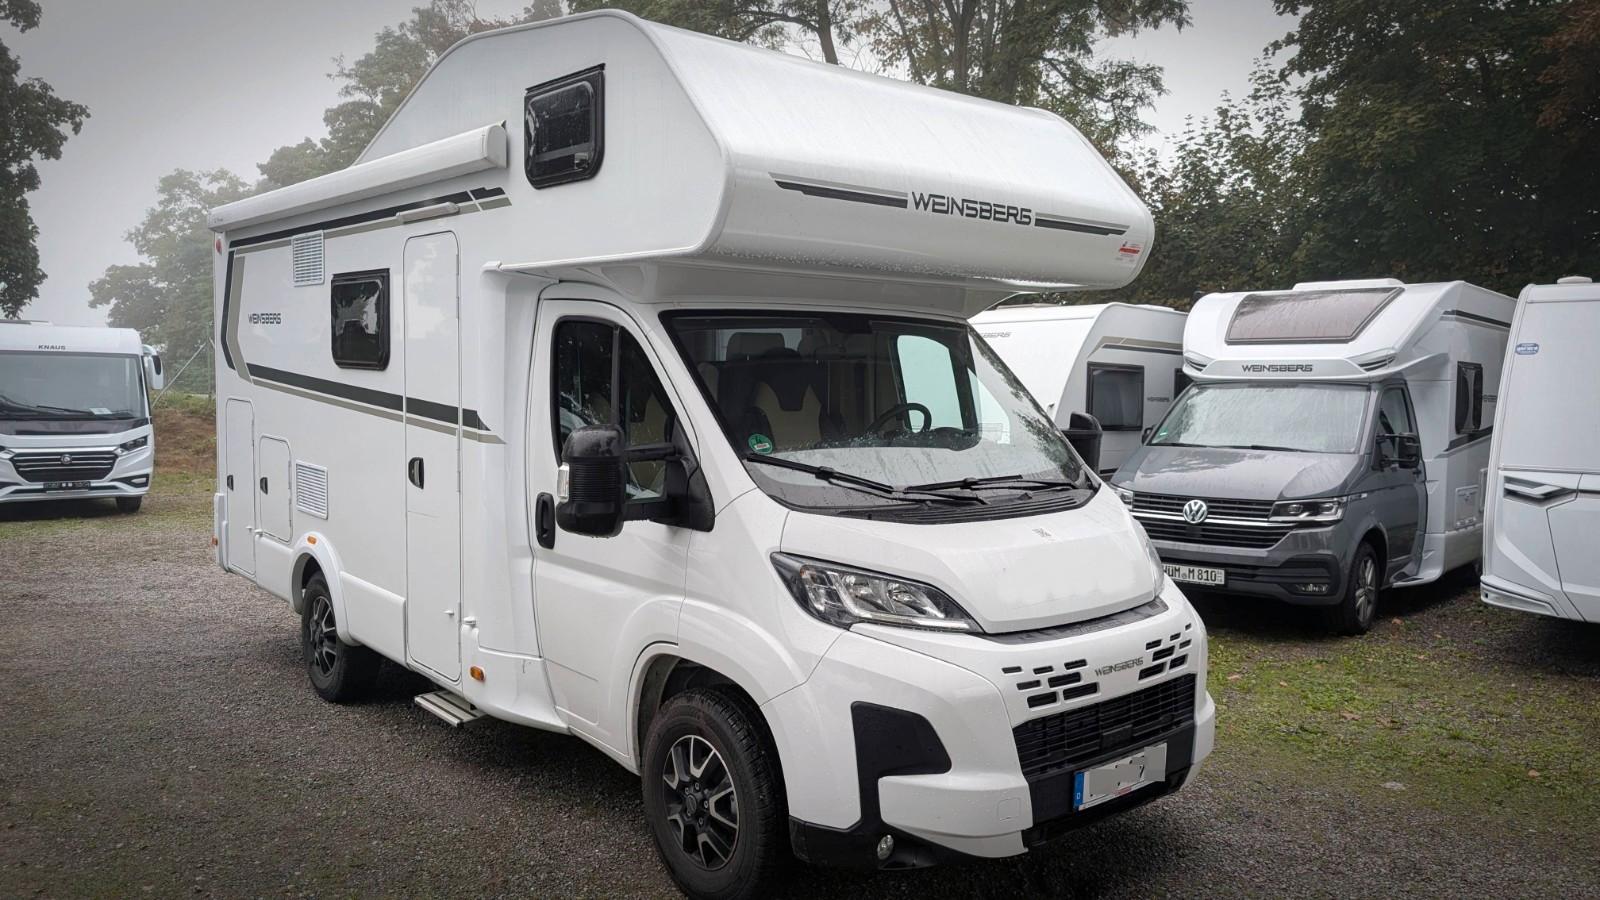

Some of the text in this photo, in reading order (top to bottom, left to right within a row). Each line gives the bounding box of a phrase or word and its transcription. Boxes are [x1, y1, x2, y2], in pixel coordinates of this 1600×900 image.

[911, 191, 1032, 225] WEINSBERG
[1241, 364, 1313, 373] WEINSBERG
[1188, 567, 1195, 580] M
[1197, 568, 1217, 582] 810
[1094, 656, 1144, 677] WEINSBERG
